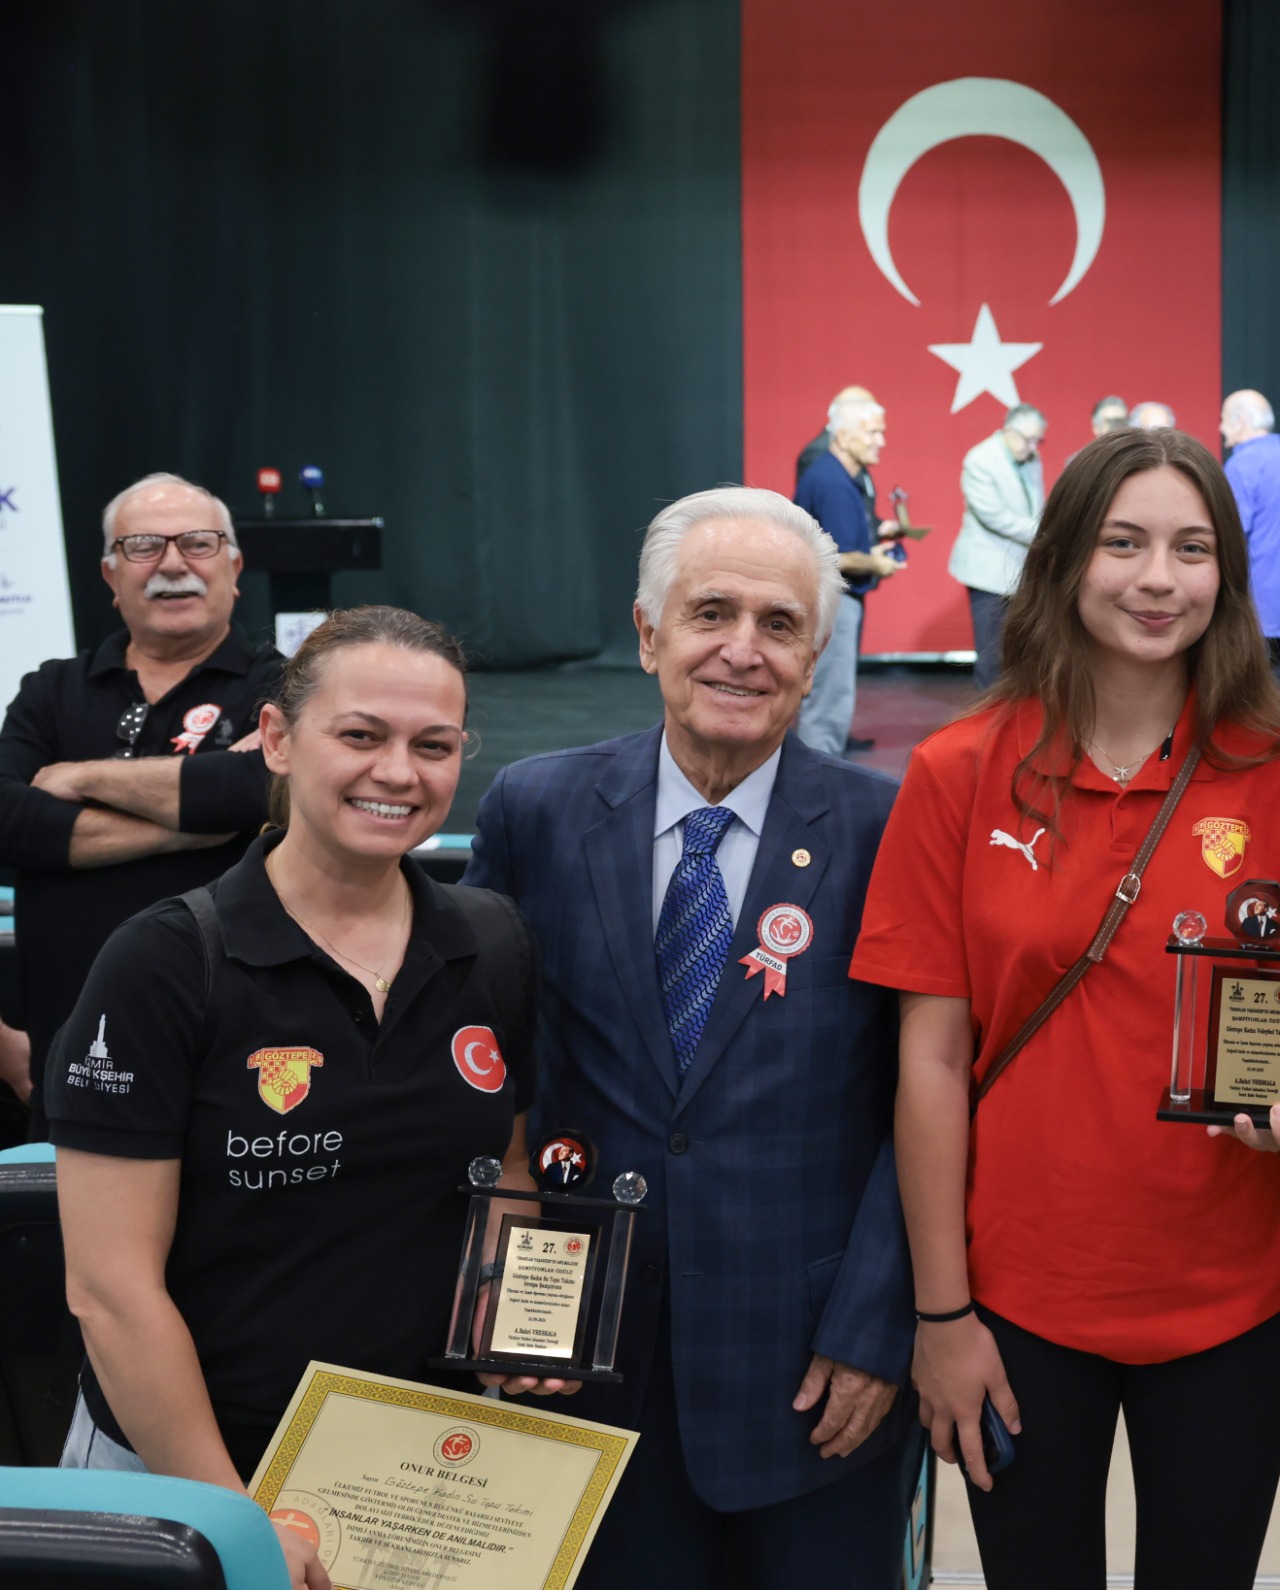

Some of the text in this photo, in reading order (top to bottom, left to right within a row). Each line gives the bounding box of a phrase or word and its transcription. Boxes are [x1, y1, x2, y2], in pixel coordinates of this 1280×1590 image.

[755, 951, 783, 971] TÜRFAD
[1254, 993, 1268, 1004] 27.
[227, 1130, 343, 1157] before
[229, 1159, 341, 1189] sunset
[543, 1243, 556, 1254] 27.
[400, 1462, 488, 1488] ONUR BELGESİ
[365, 1487, 389, 1500] FUTBOL
[380, 1518, 431, 1539] YAŞARKEN
[432, 1530, 446, 1541] DE
